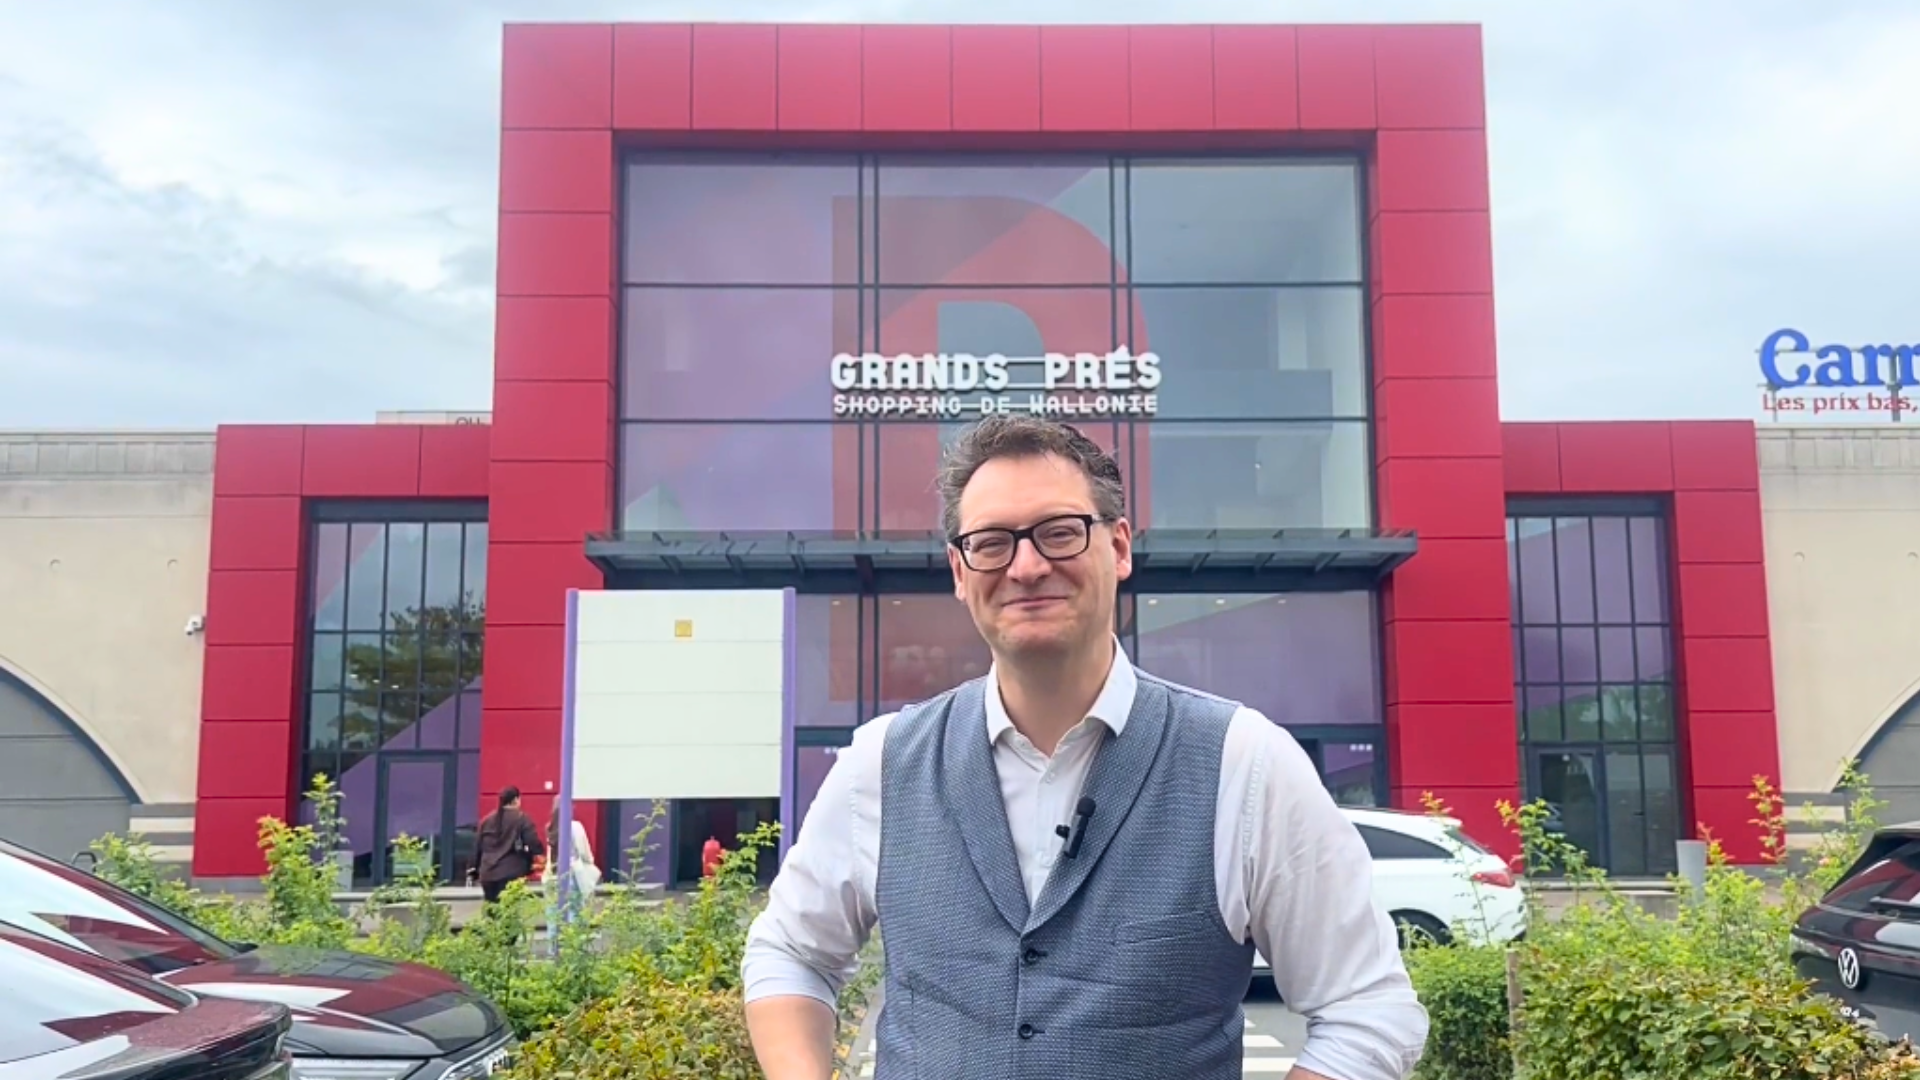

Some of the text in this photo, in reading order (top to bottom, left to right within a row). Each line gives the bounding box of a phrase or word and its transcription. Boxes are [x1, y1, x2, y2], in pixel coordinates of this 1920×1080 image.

[830, 344, 1162, 390] GRANDS PRÉS
[833, 394, 1158, 416] SHOPPING DE WALLONIE
[1763, 393, 1805, 411] Les
[1867, 392, 1918, 413] bas,
